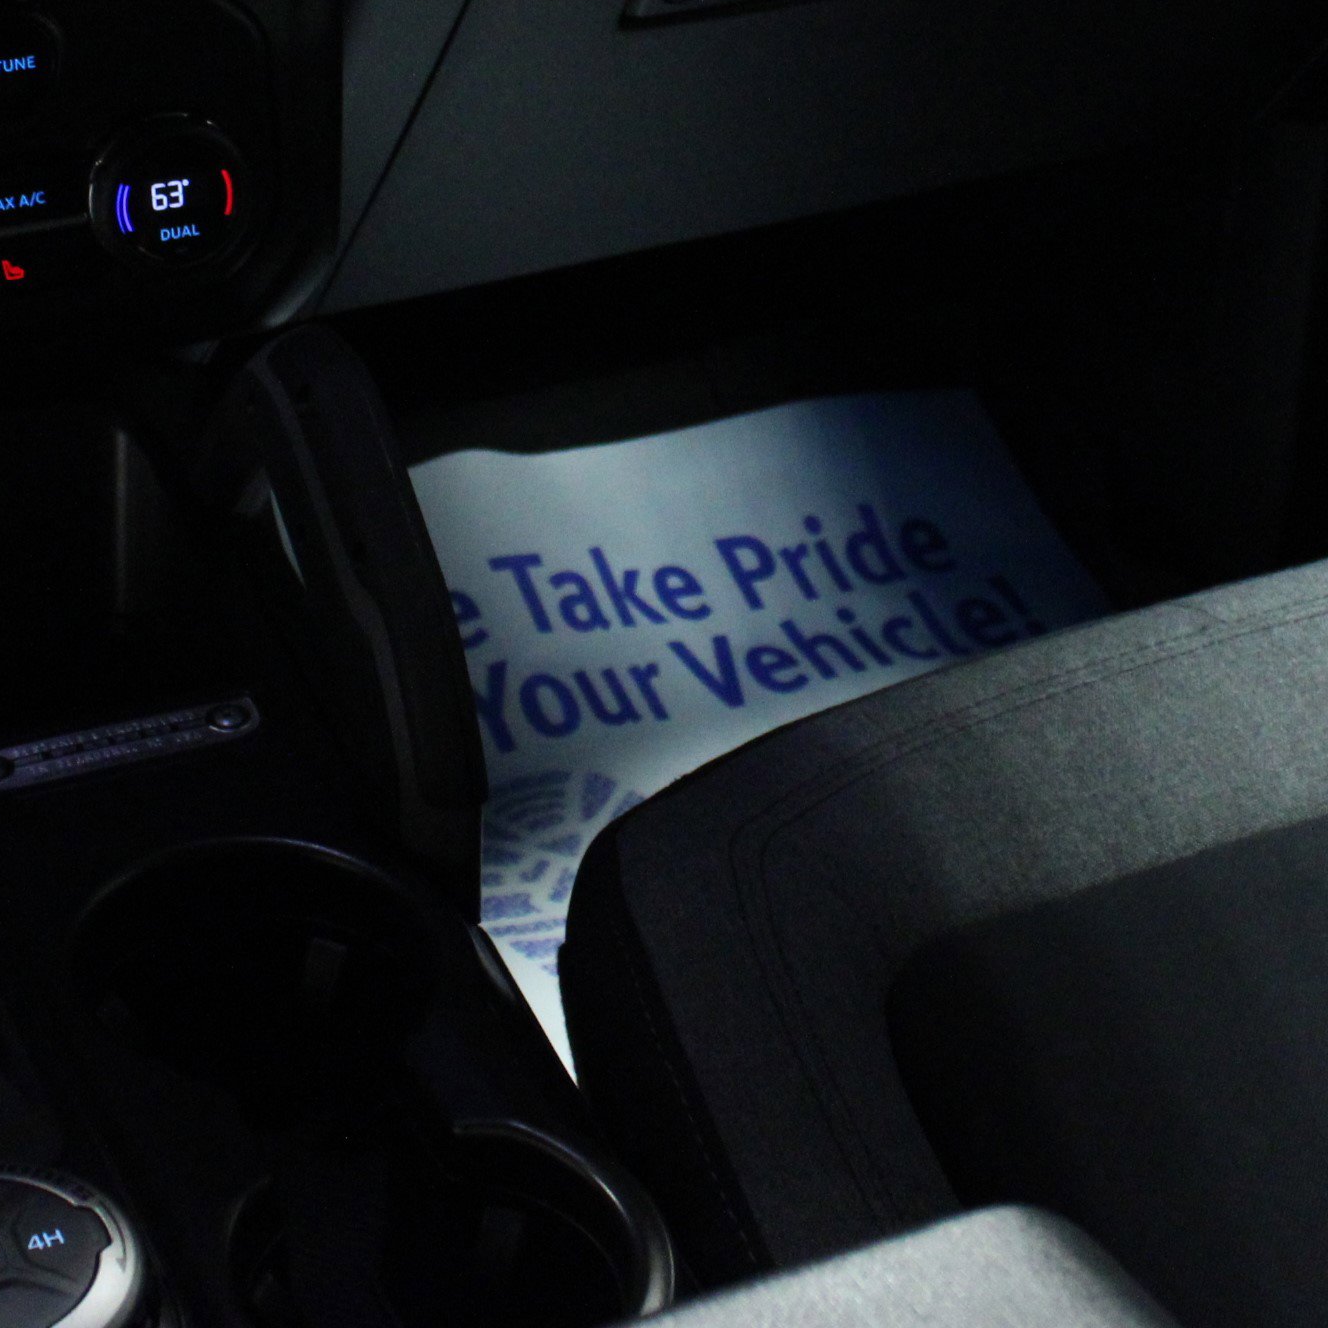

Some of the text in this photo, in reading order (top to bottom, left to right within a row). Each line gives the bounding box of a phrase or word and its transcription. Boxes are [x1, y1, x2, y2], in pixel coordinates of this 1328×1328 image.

[18, 191, 46, 208] A/C
[160, 224, 201, 242] DUAL
[489, 546, 711, 636] Take
[714, 502, 957, 610] Pride
[475, 576, 1047, 754] Your Vehicle!
[27, 1228, 65, 1250] 4H
